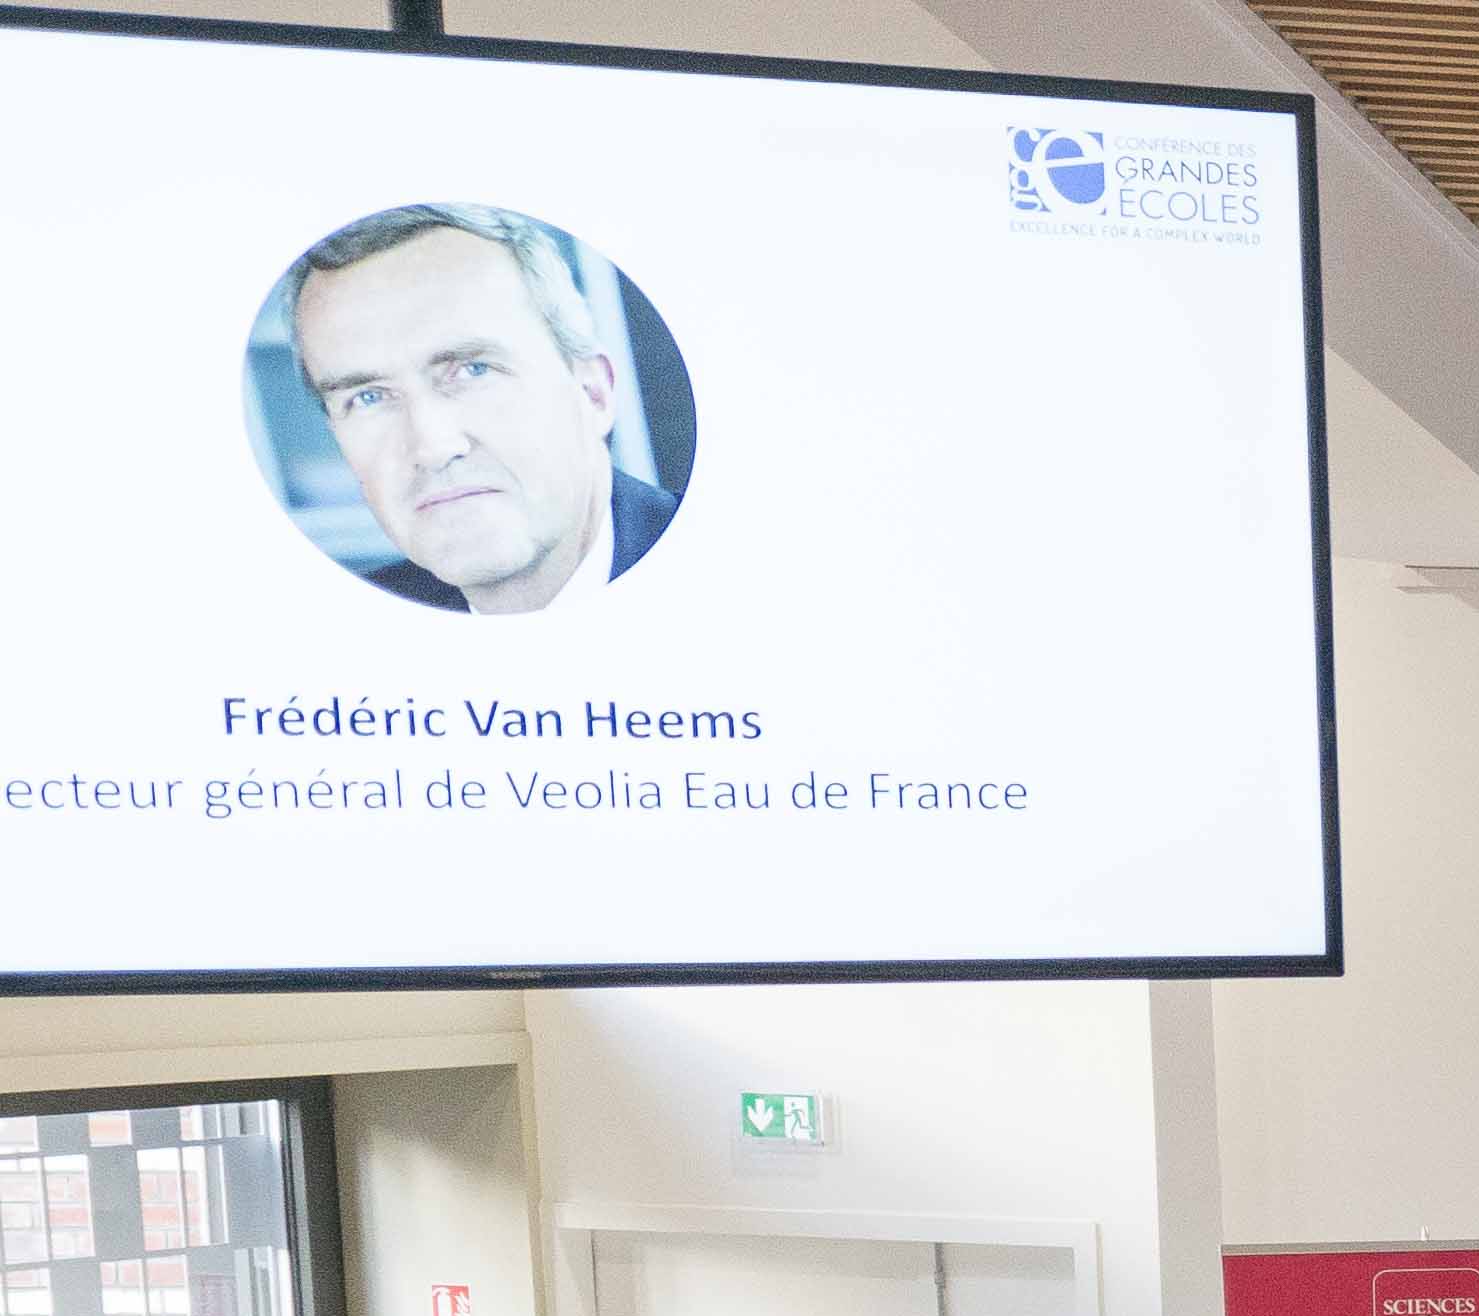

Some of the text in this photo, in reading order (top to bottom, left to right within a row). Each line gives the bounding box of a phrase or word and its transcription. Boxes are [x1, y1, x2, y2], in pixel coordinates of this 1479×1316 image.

[1115, 156, 1258, 187] GRANDES
[222, 696, 763, 740] Frédéric Van Heems
[206, 768, 403, 819] général
[426, 769, 487, 809] de
[505, 770, 662, 809] Veolia
[686, 772, 770, 809] Eau
[791, 771, 848, 809] de
[871, 773, 1028, 809] France
[1383, 1297, 1476, 1316] SCIENCES
